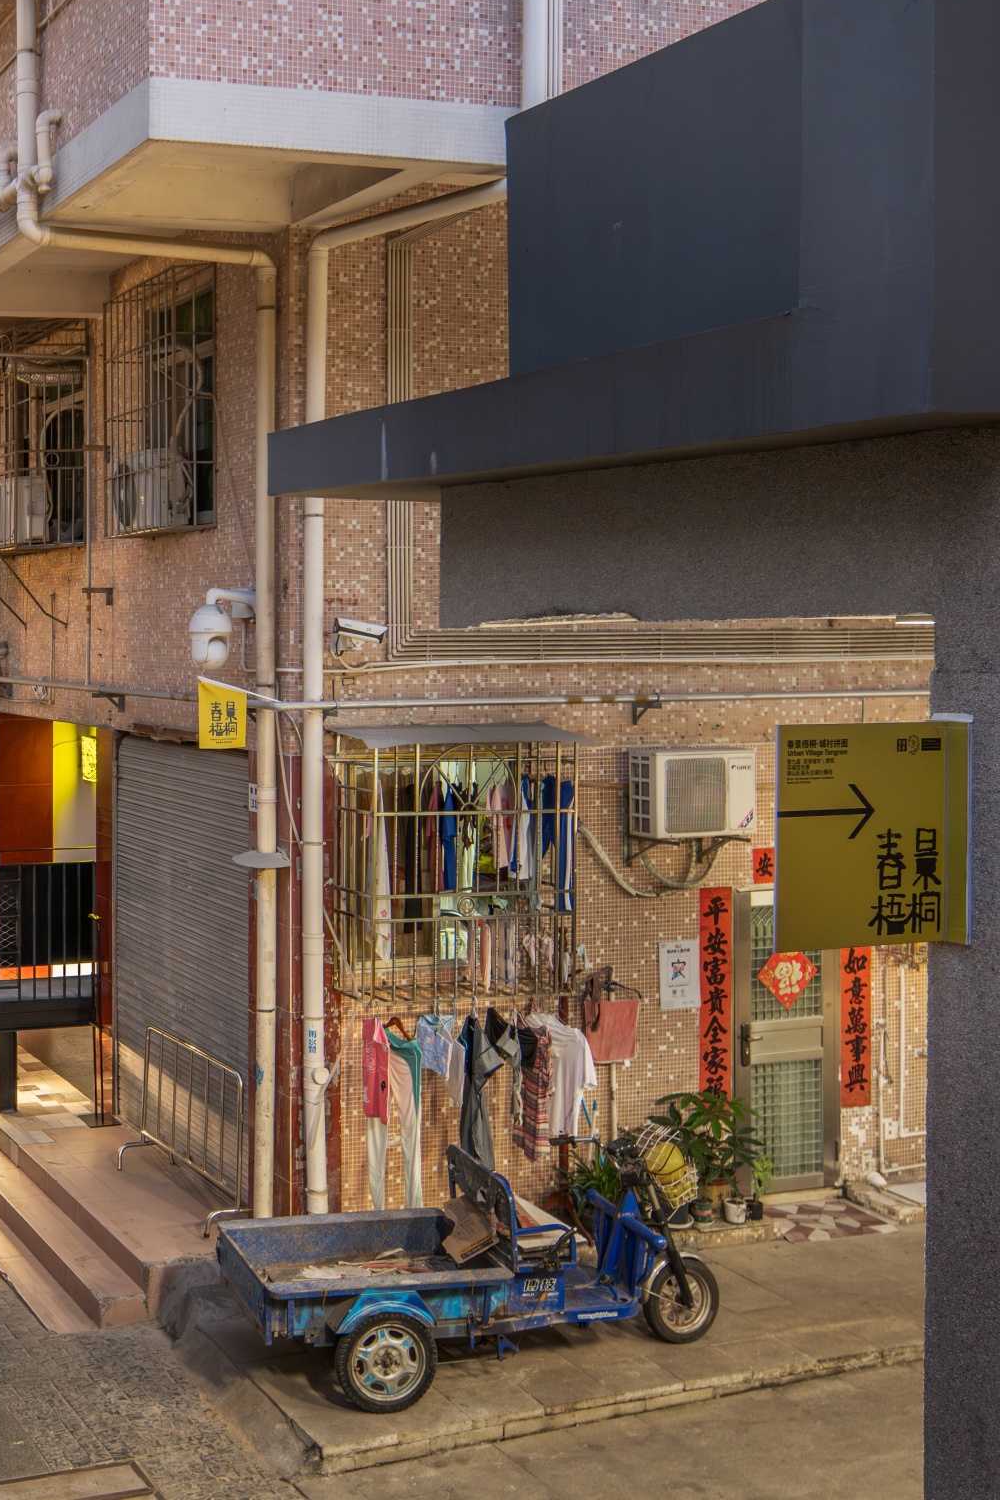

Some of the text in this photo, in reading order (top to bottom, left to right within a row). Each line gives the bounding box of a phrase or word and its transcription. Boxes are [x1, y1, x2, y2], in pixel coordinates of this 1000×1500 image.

[755, 852, 774, 877] 安
[876, 827, 942, 891] 春景
[868, 891, 941, 936] 梧桐
[774, 960, 803, 996] 福
